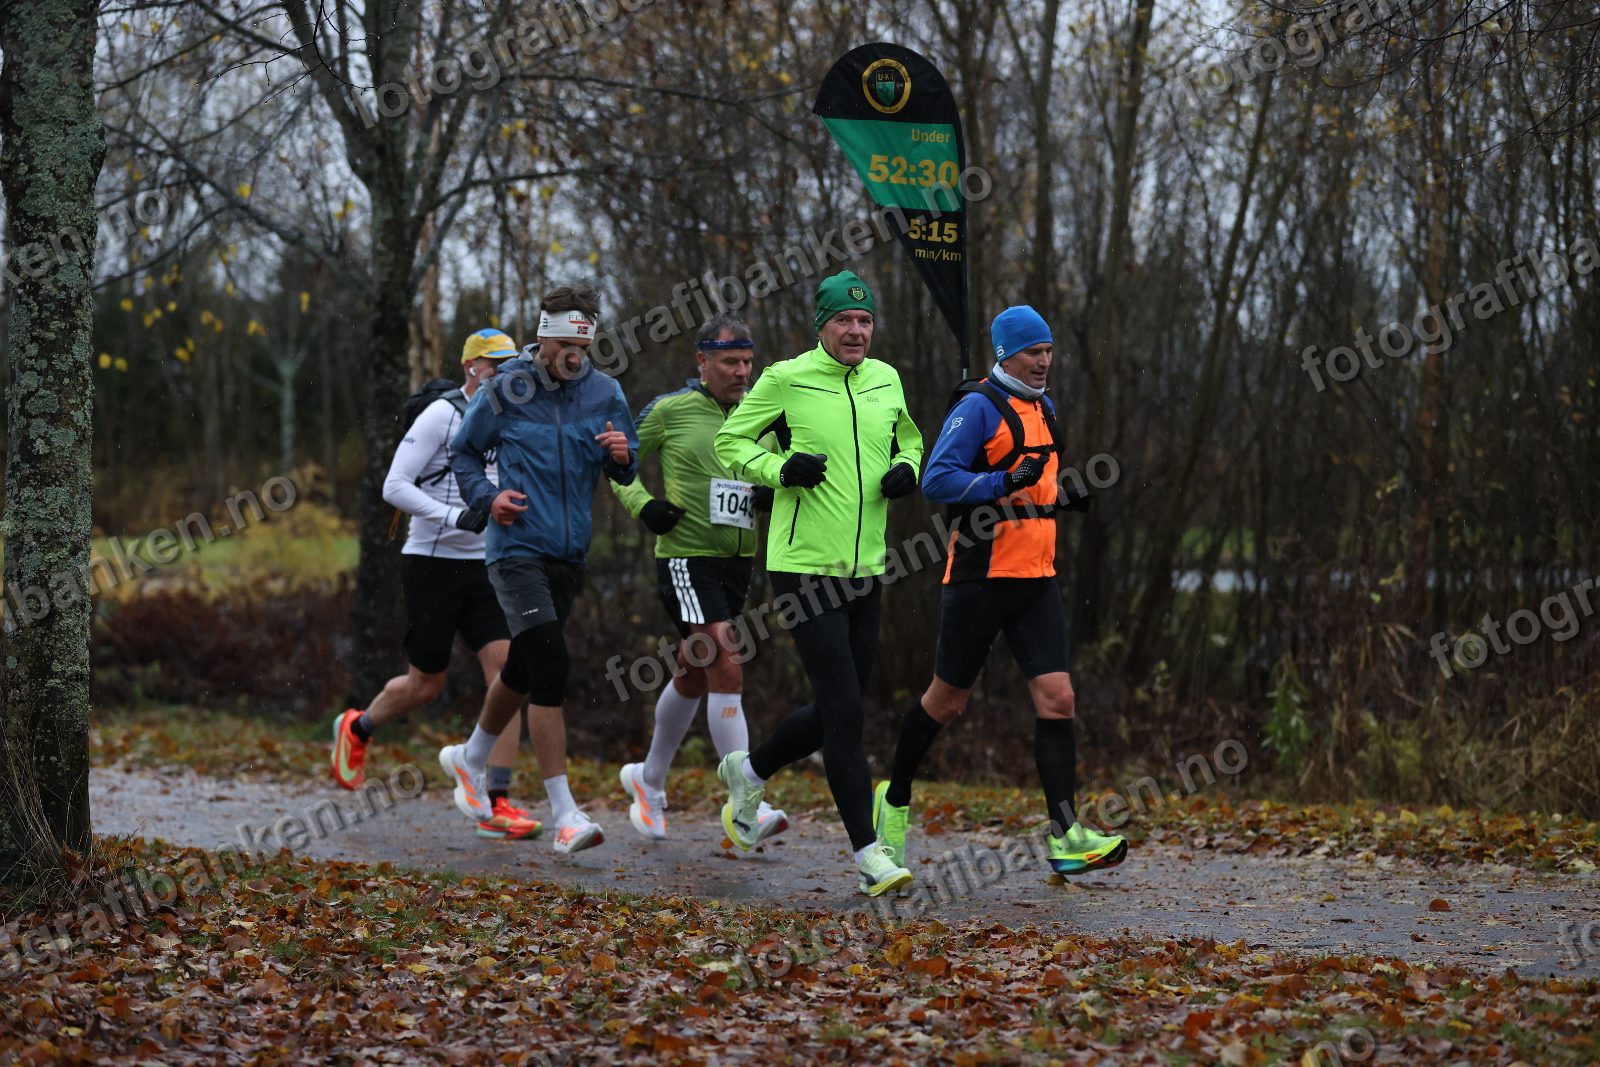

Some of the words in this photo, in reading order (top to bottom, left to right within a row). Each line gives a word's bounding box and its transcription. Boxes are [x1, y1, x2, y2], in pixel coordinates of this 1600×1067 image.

[911, 128, 951, 143] Under
[867, 154, 959, 188] 52:30
[908, 218, 958, 244] 5:15
[914, 247, 962, 263] min/km
